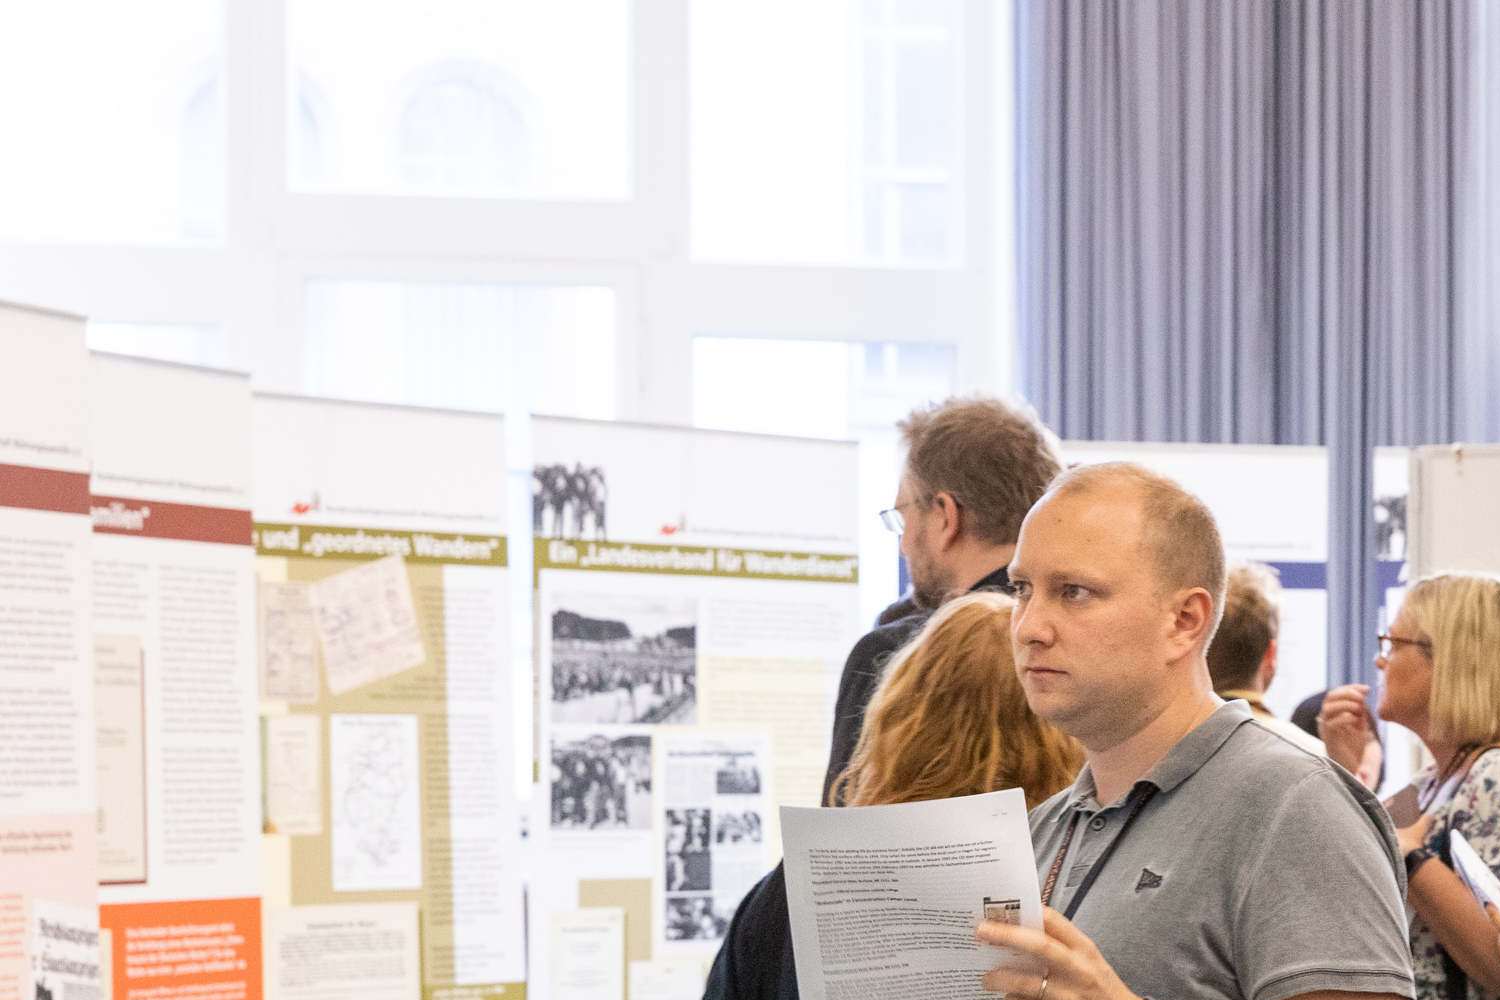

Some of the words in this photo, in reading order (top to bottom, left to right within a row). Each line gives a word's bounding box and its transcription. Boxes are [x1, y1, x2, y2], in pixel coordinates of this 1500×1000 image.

[262, 525, 299, 550] und
[548, 540, 578, 564] Ein
[716, 548, 742, 573] für
